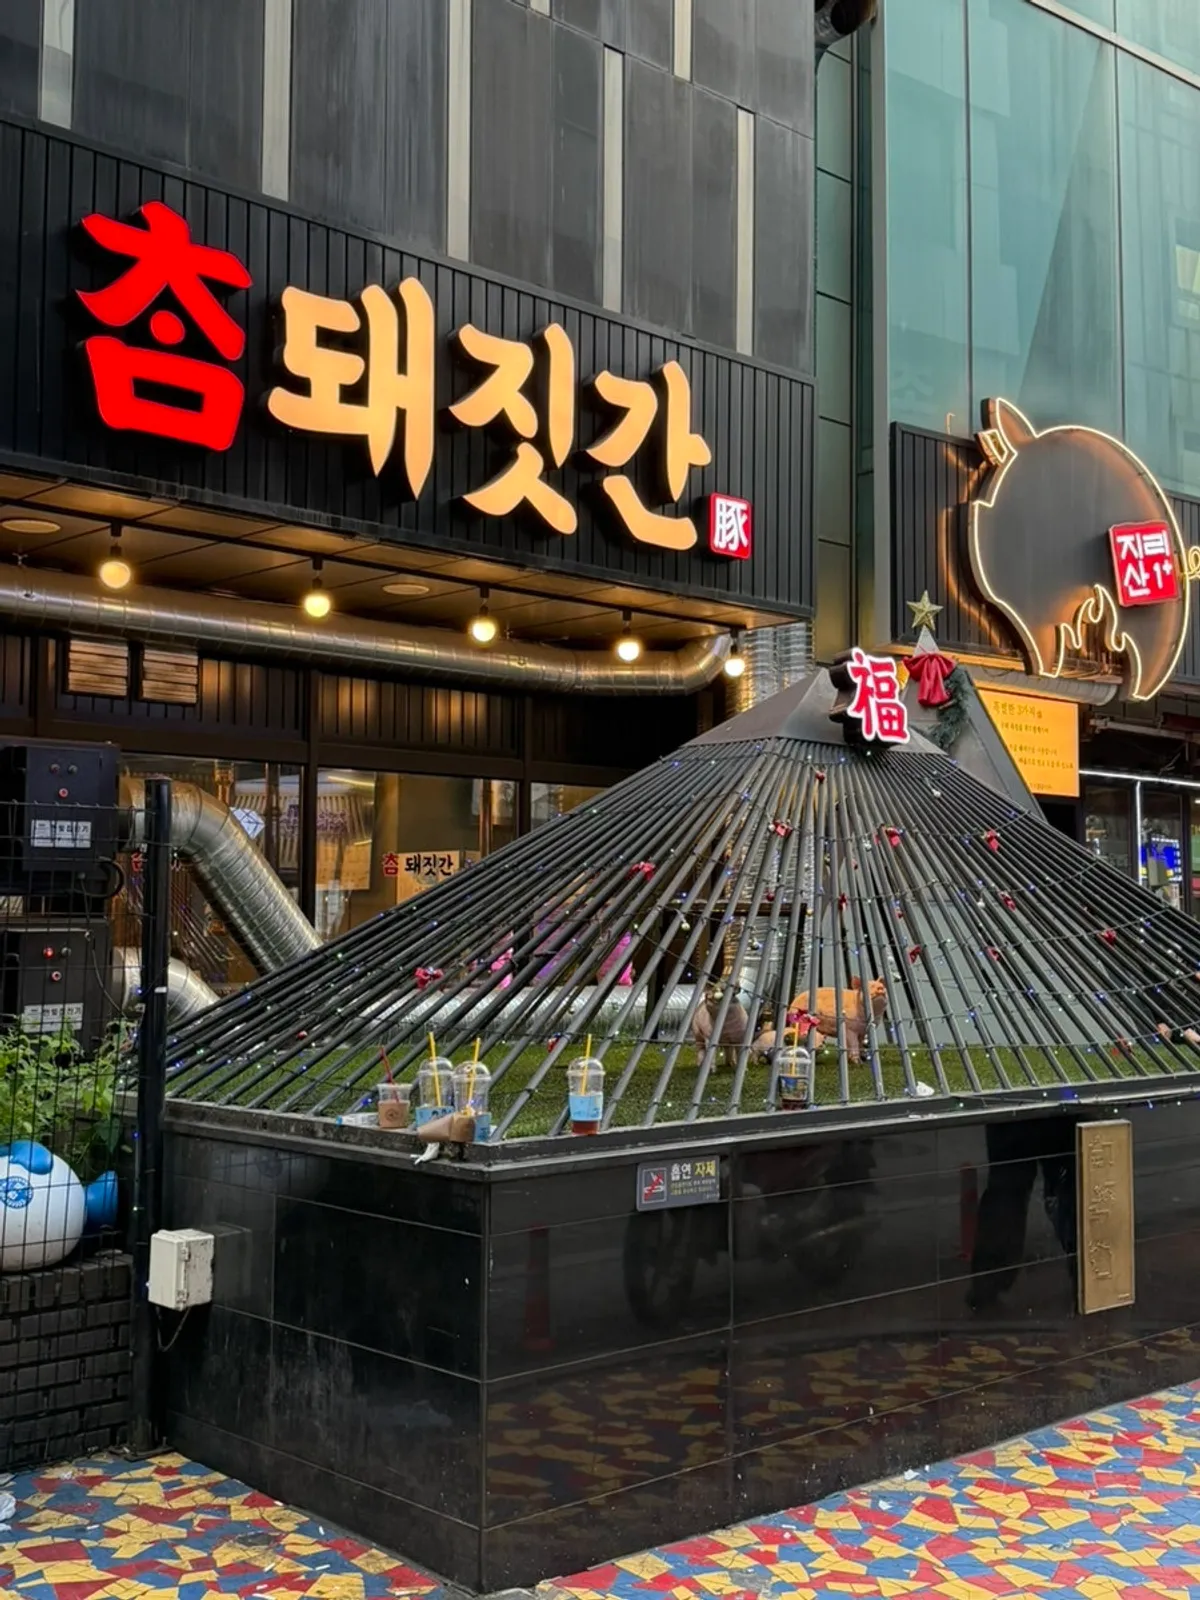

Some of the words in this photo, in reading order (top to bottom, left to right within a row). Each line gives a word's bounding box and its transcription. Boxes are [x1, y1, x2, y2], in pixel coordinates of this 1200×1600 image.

[267, 276, 712, 552] 돼짓간
[713, 496, 749, 552] 豚
[1115, 529, 1171, 561] 지리
[1122, 559, 1151, 598] 산
[847, 646, 911, 744] 福
[404, 853, 454, 876] 돼짓간
[671, 1162, 692, 1180] 흡연
[694, 1160, 716, 1178] 자제
